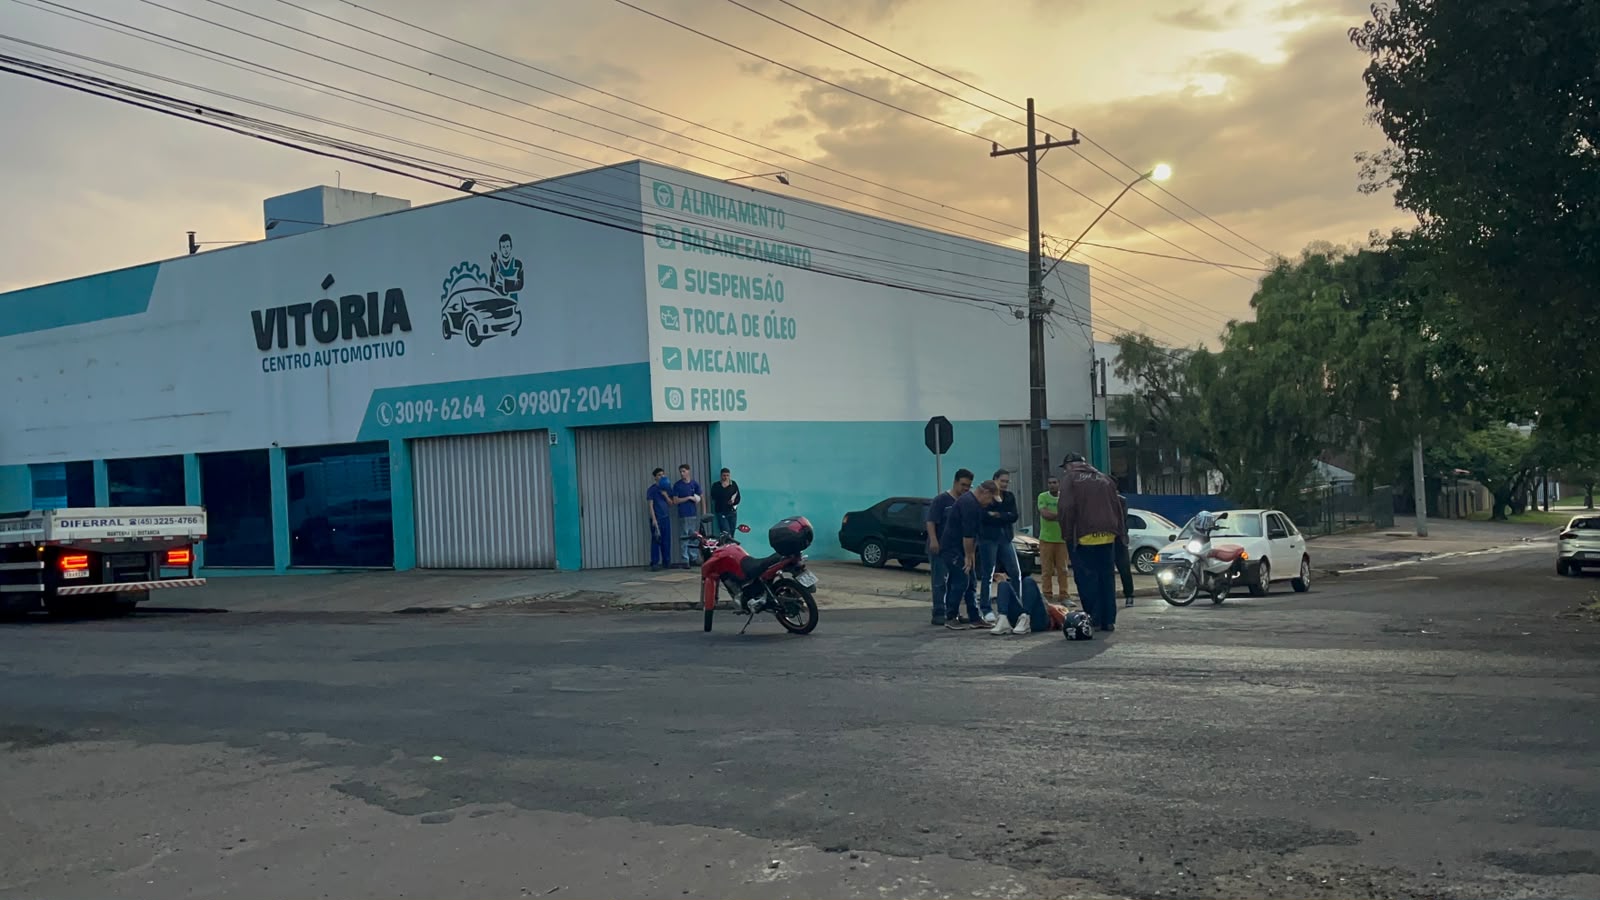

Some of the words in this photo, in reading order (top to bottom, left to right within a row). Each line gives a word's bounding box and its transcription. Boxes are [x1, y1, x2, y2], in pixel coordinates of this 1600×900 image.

[680, 187, 785, 230] ALINHAMENTO
[682, 227, 811, 267] BALANCEAMENTO
[684, 268, 785, 303] SUSPENSÃO
[251, 273, 412, 351] VITÓRIA
[683, 308, 737, 336] TROCA
[741, 313, 760, 337] DE
[764, 309, 796, 340] ÓLEO
[262, 352, 311, 373] CENTRO
[314, 340, 405, 366] AUTOMOTIVO
[687, 345, 770, 375] MECÂNICA
[395, 394, 486, 424] 3099-6264
[519, 383, 622, 416] 99807-2041
[690, 388, 747, 411] FREIOS
[60, 518, 124, 528] DIFERRAL
[153, 516, 198, 525] 3225-4766
